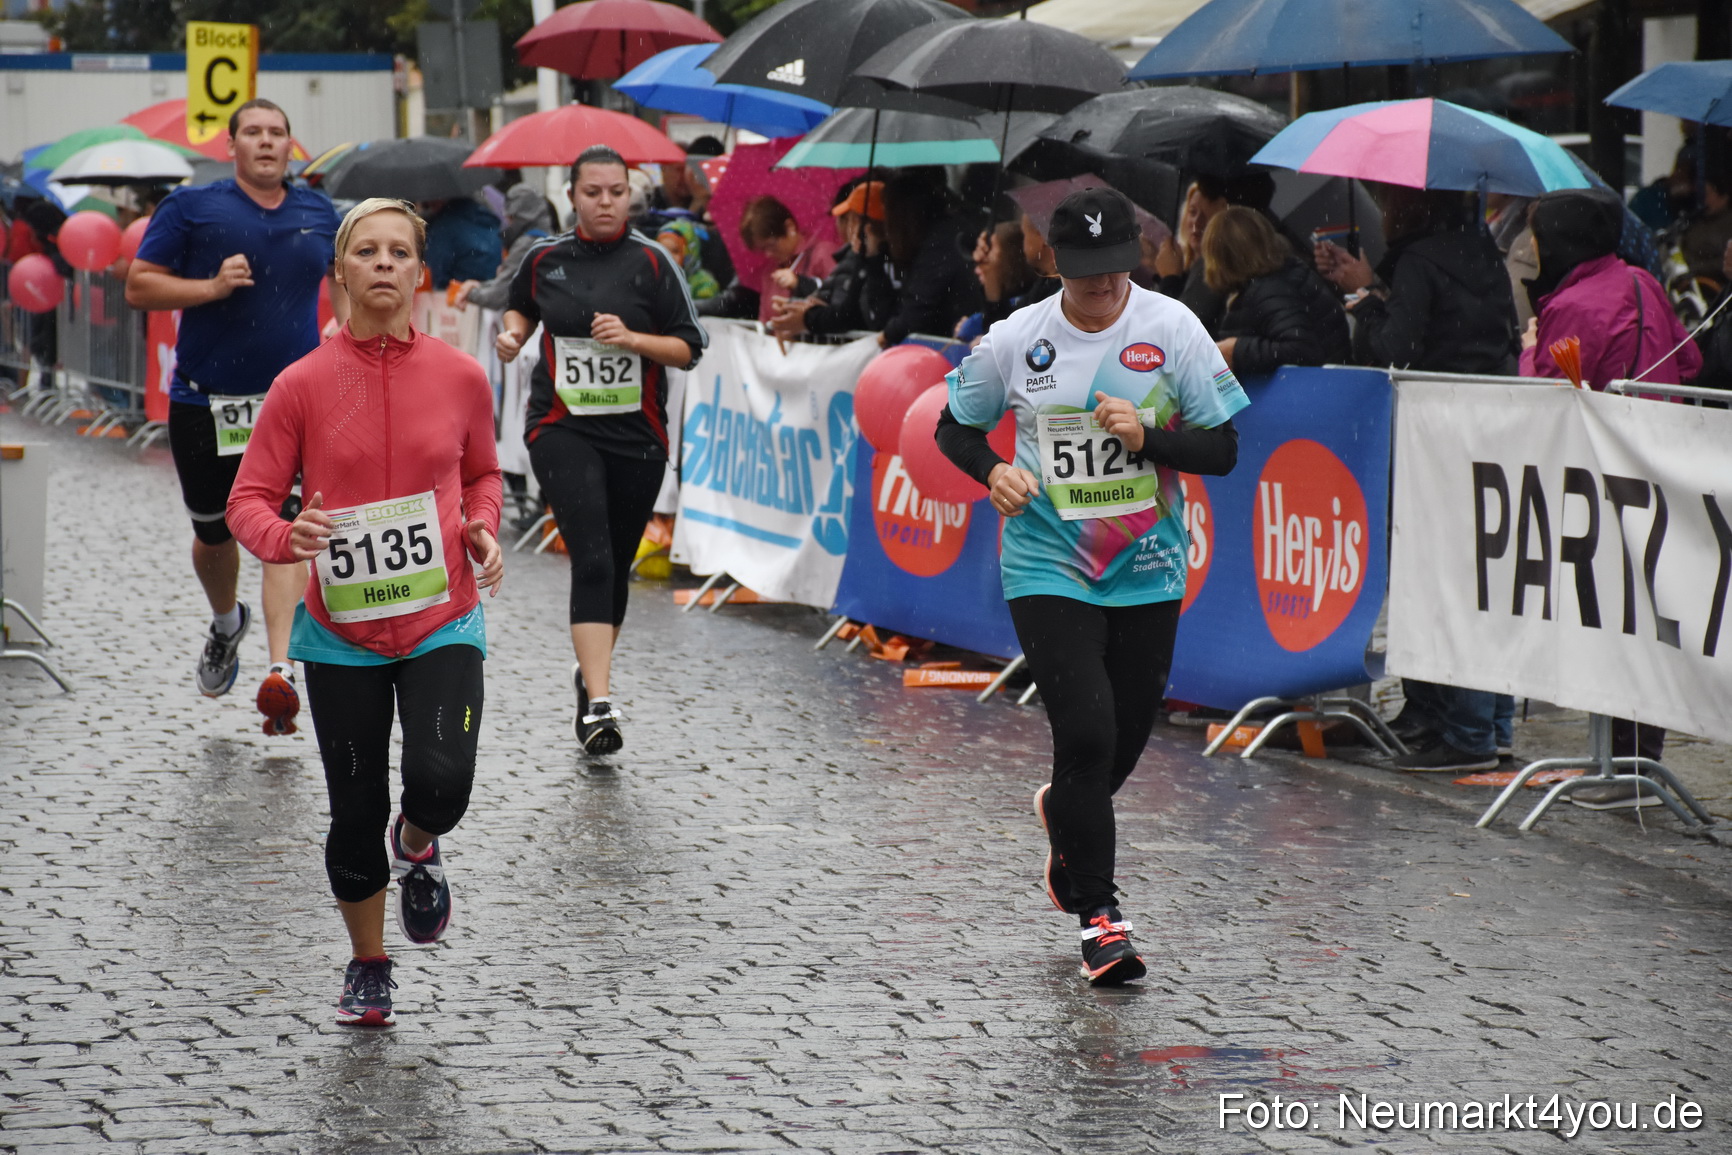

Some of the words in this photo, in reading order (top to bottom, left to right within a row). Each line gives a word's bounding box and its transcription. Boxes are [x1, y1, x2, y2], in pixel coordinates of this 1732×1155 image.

[195, 27, 249, 48] Block
[204, 56, 238, 106] C
[1126, 350, 1161, 365] Hervis
[565, 356, 633, 385] 5152
[1026, 374, 1057, 388] PARTL
[1026, 383, 1057, 394] Neumarkt
[580, 392, 619, 404] Marina
[222, 400, 253, 425] 51
[1047, 425, 1084, 433] NeuerMarkt
[1046, 476, 1052, 484] S
[1069, 485, 1135, 505] Manuela
[365, 498, 427, 521] BOCK
[881, 520, 934, 550] SPORTS
[1139, 534, 1159, 552] 17.
[328, 522, 433, 580] 5135
[1260, 480, 1362, 614] Hervis
[323, 576, 331, 586] S
[363, 583, 411, 604] Heike
[1266, 591, 1312, 620] SPORTS
[928, 670, 991, 685] BRANDING
